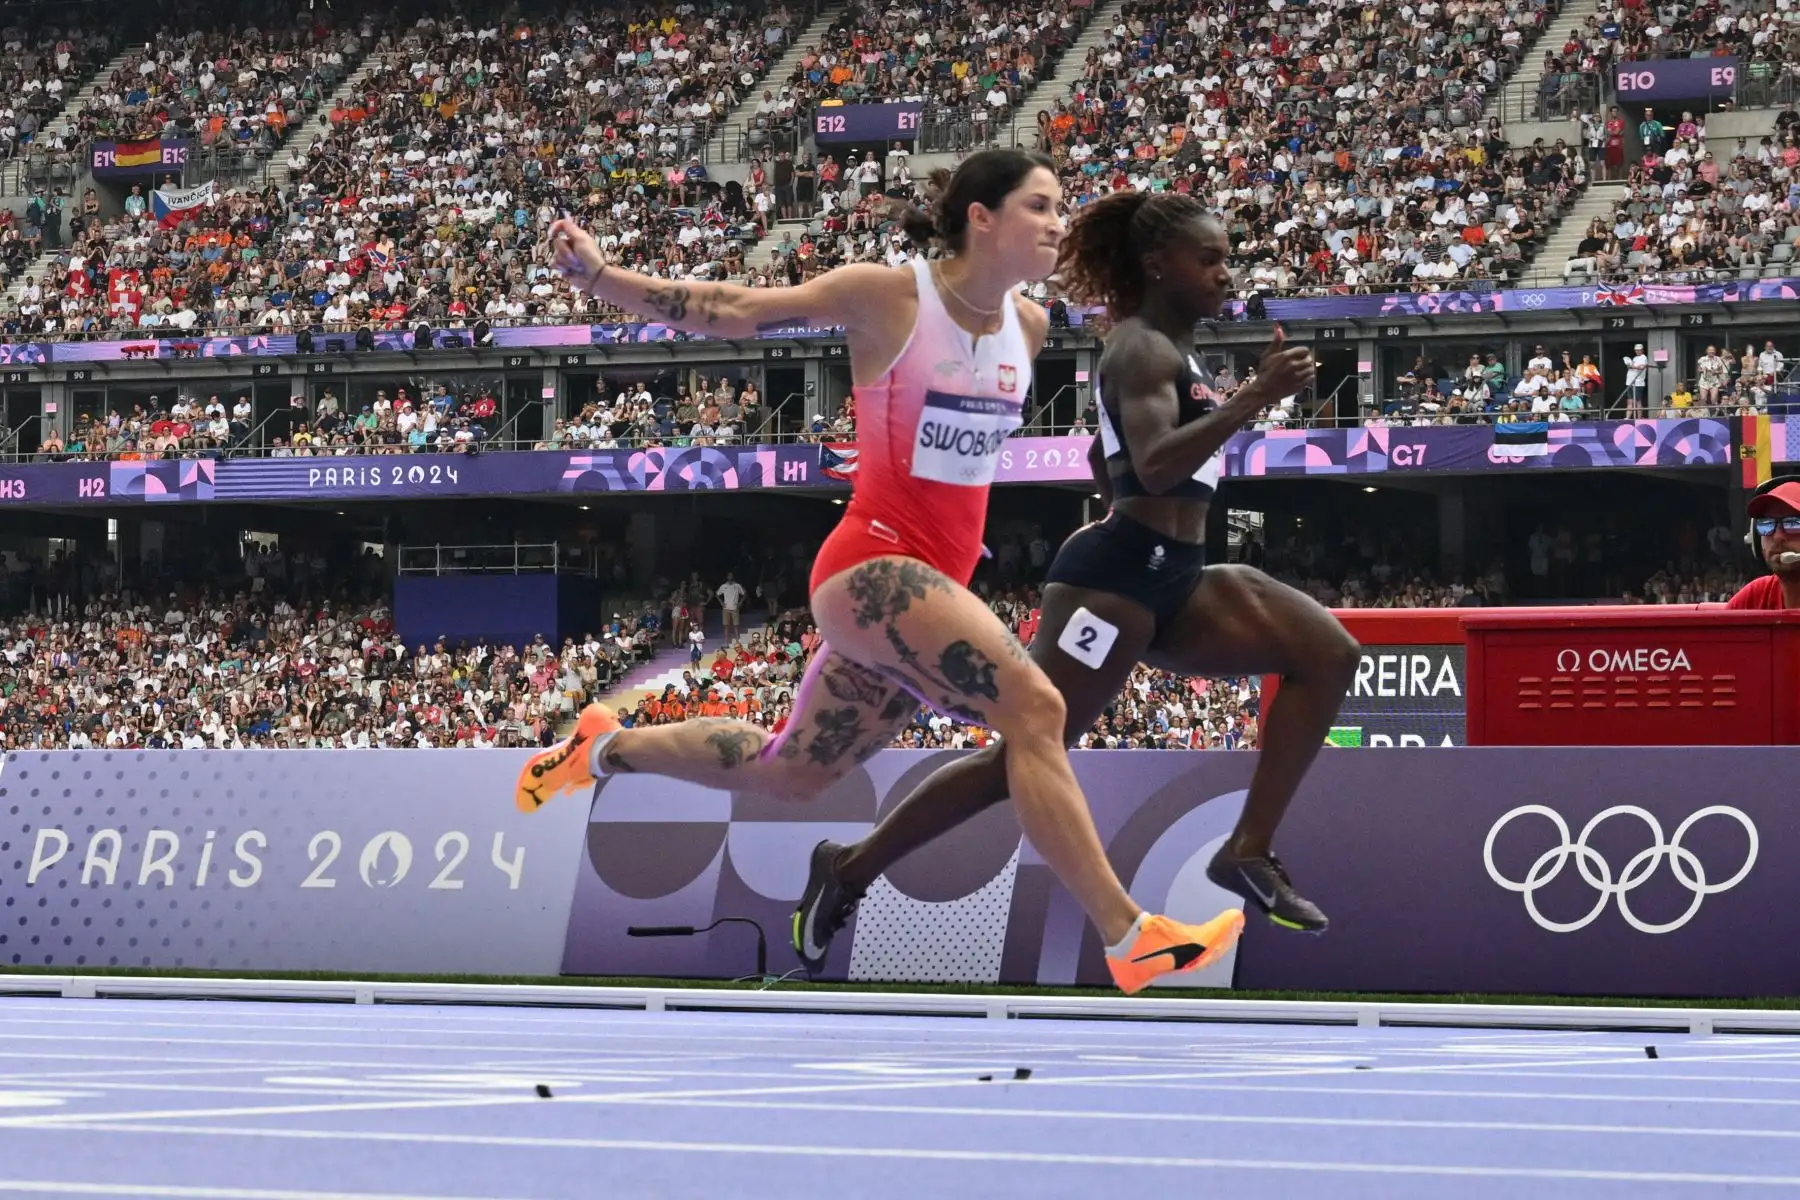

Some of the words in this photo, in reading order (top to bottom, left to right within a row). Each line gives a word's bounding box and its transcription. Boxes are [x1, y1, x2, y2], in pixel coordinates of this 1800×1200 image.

[1617, 71, 1655, 91] E10
[1711, 67, 1736, 86] E9
[816, 115, 846, 133] E12
[1611, 318, 1625, 328] 79
[1689, 315, 1703, 324] 78
[1323, 328, 1336, 338] 81
[1386, 326, 1400, 336] 80
[567, 356, 579, 364] 86
[771, 349, 784, 357] 85
[830, 347, 842, 355] 84
[511, 357, 522, 366] 87
[10, 373, 21, 381] 91
[73, 371, 85, 380] 90
[1392, 444, 1427, 466] G7
[391, 465, 458, 485] 2024
[783, 460, 807, 481] H1
[0, 479, 26, 498] H3
[79, 477, 105, 497] H2
[1075, 626, 1098, 653] 2
[1588, 648, 1692, 672] OMEGA
[1345, 654, 1462, 697] REIRA
[300, 830, 526, 889] 2024
